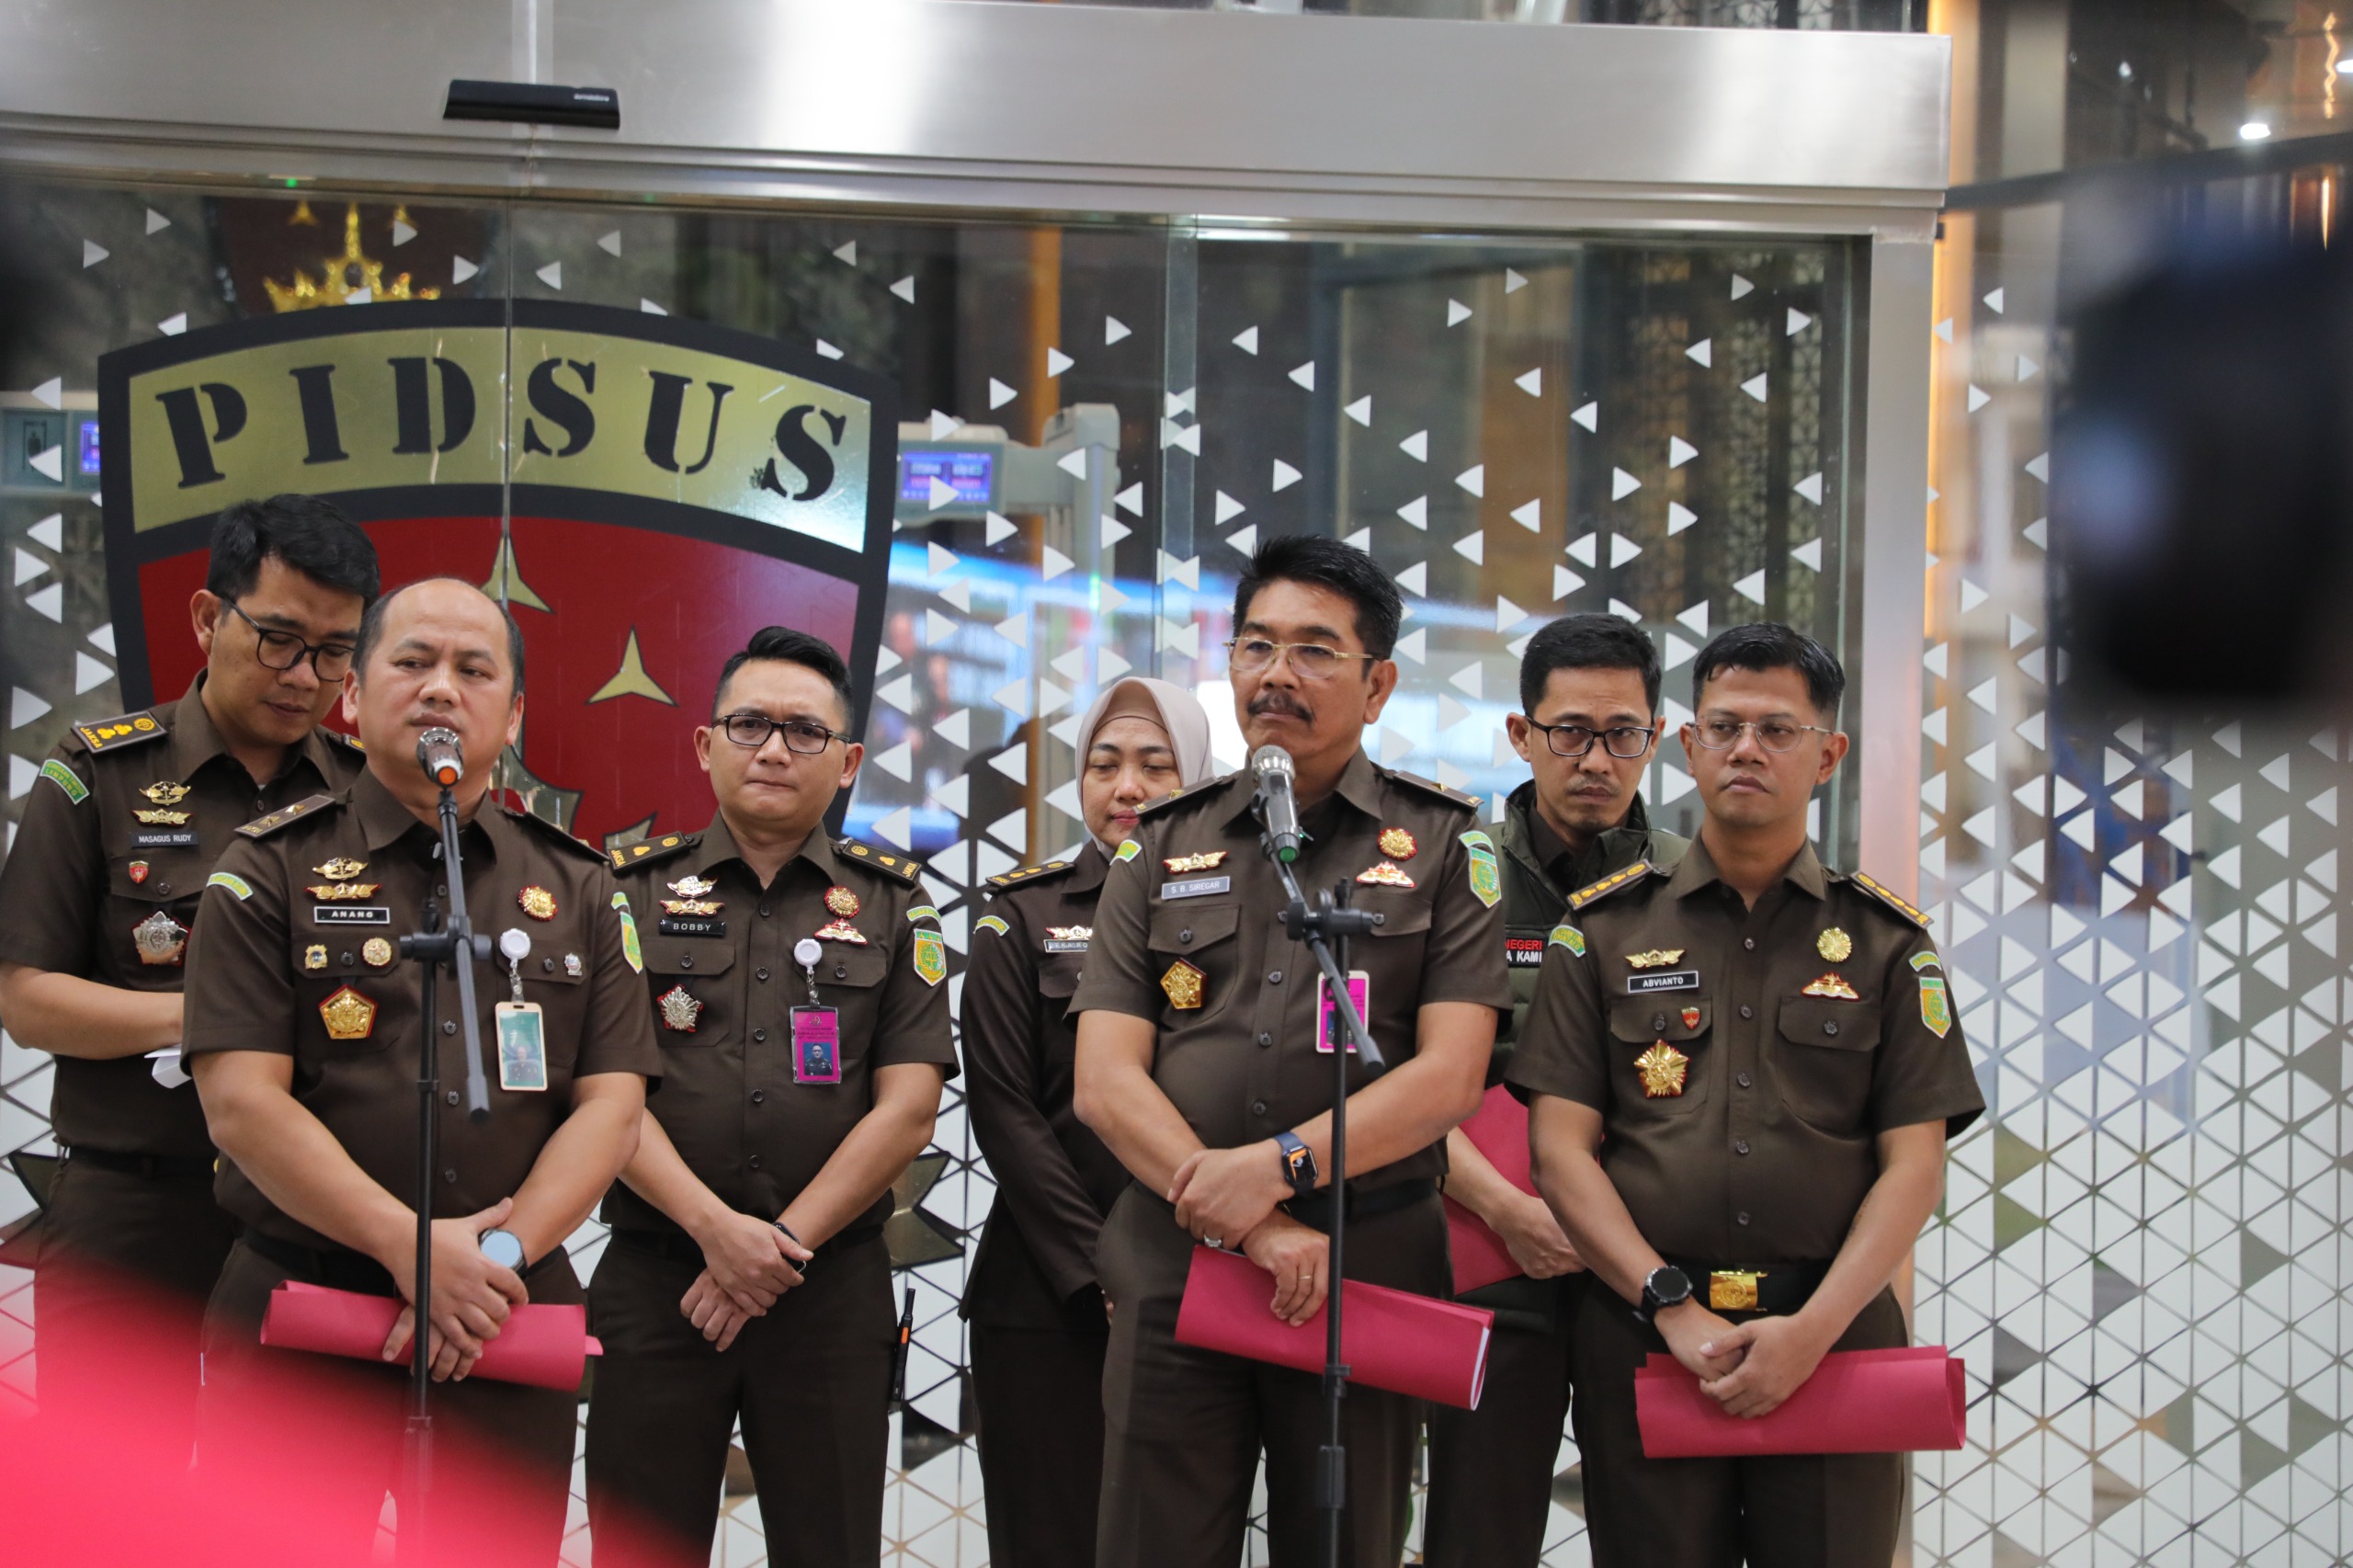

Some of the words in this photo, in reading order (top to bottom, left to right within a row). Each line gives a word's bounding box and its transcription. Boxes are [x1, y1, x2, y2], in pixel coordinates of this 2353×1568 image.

[155, 356, 848, 502] PIDSUS
[79, 726, 103, 749] JAKSA
[138, 835, 171, 843] MASAGUS
[173, 834, 192, 843] RUDY
[1188, 881, 1221, 892] SIREGAR
[331, 910, 374, 918] ANANG
[673, 923, 711, 931] BOBBY
[1517, 951, 1542, 962] KAMI
[1643, 976, 1684, 988] ABVIANTO
